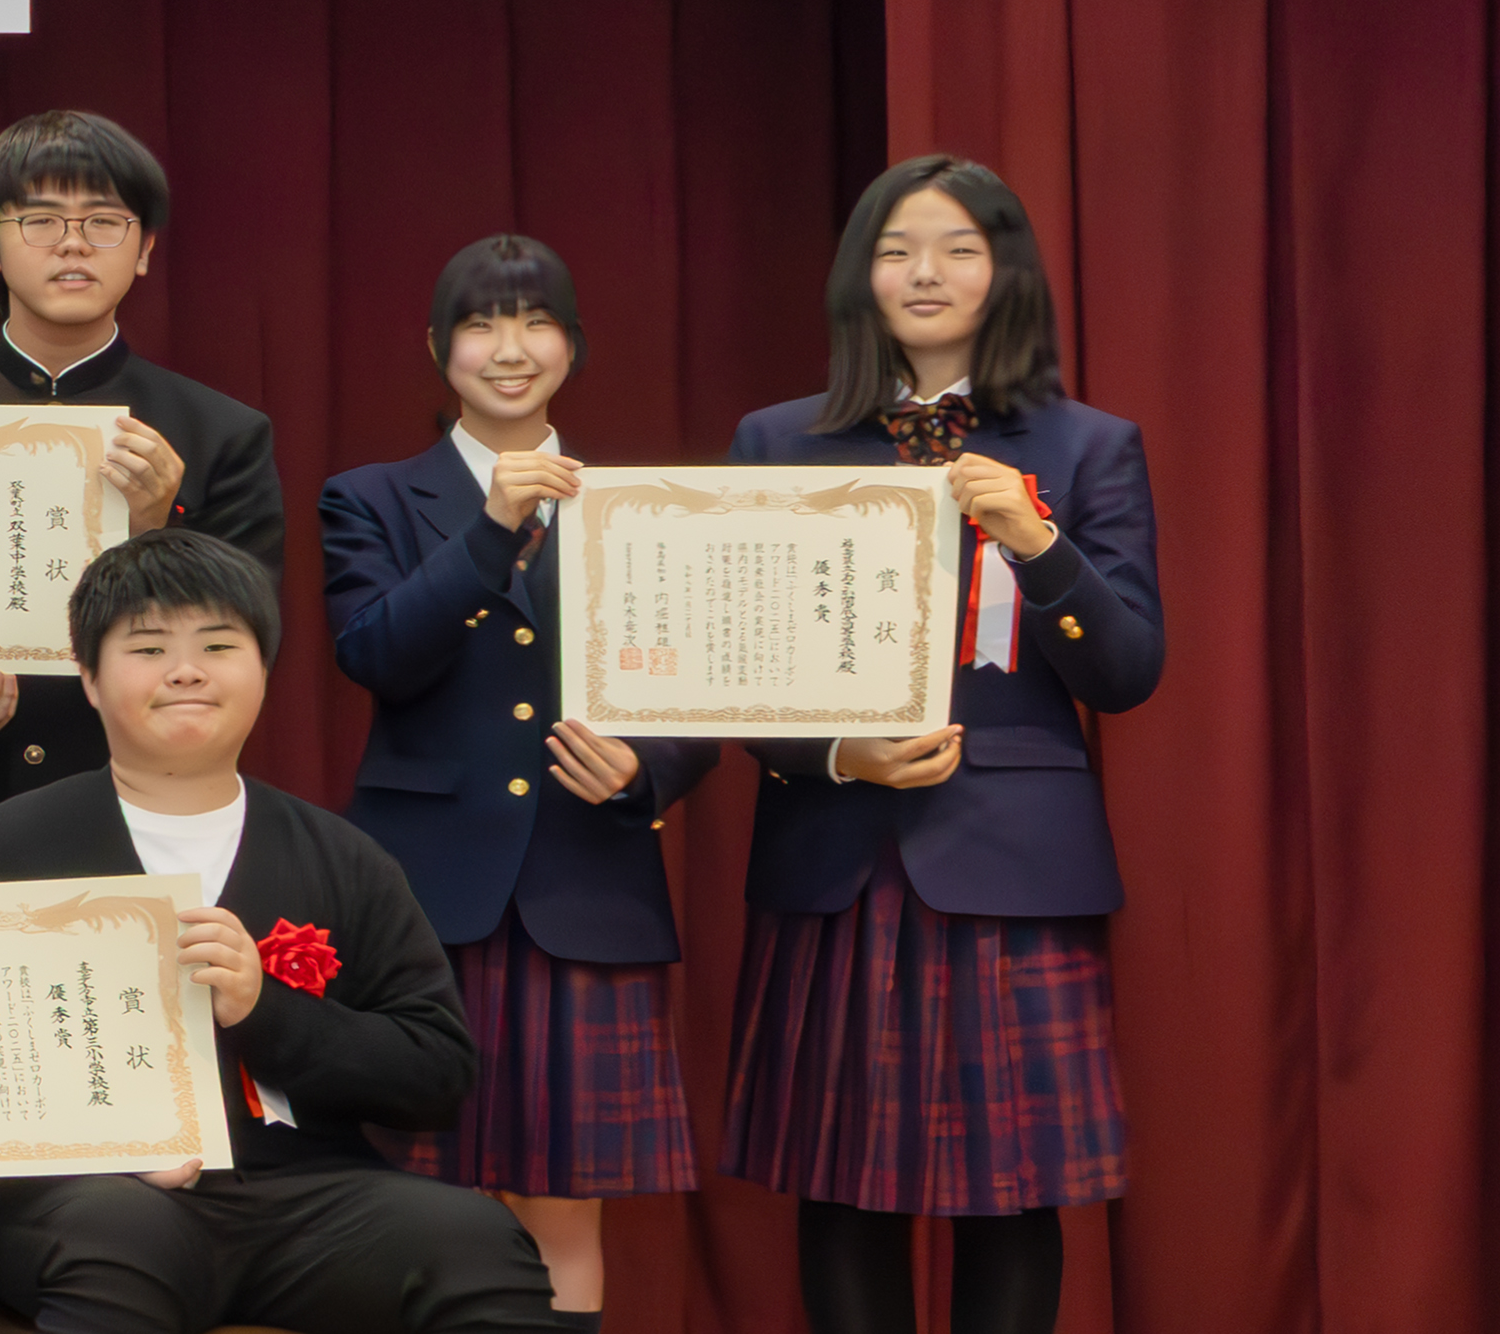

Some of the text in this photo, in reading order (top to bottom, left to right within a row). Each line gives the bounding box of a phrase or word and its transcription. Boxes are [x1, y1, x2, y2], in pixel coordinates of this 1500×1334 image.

[44, 505, 69, 582] 賞状
[811, 559, 833, 623] 優秀賞
[872, 567, 899, 644] 賞状
[45, 983, 73, 1049] 優秀賞
[118, 986, 154, 1070] 賞状
